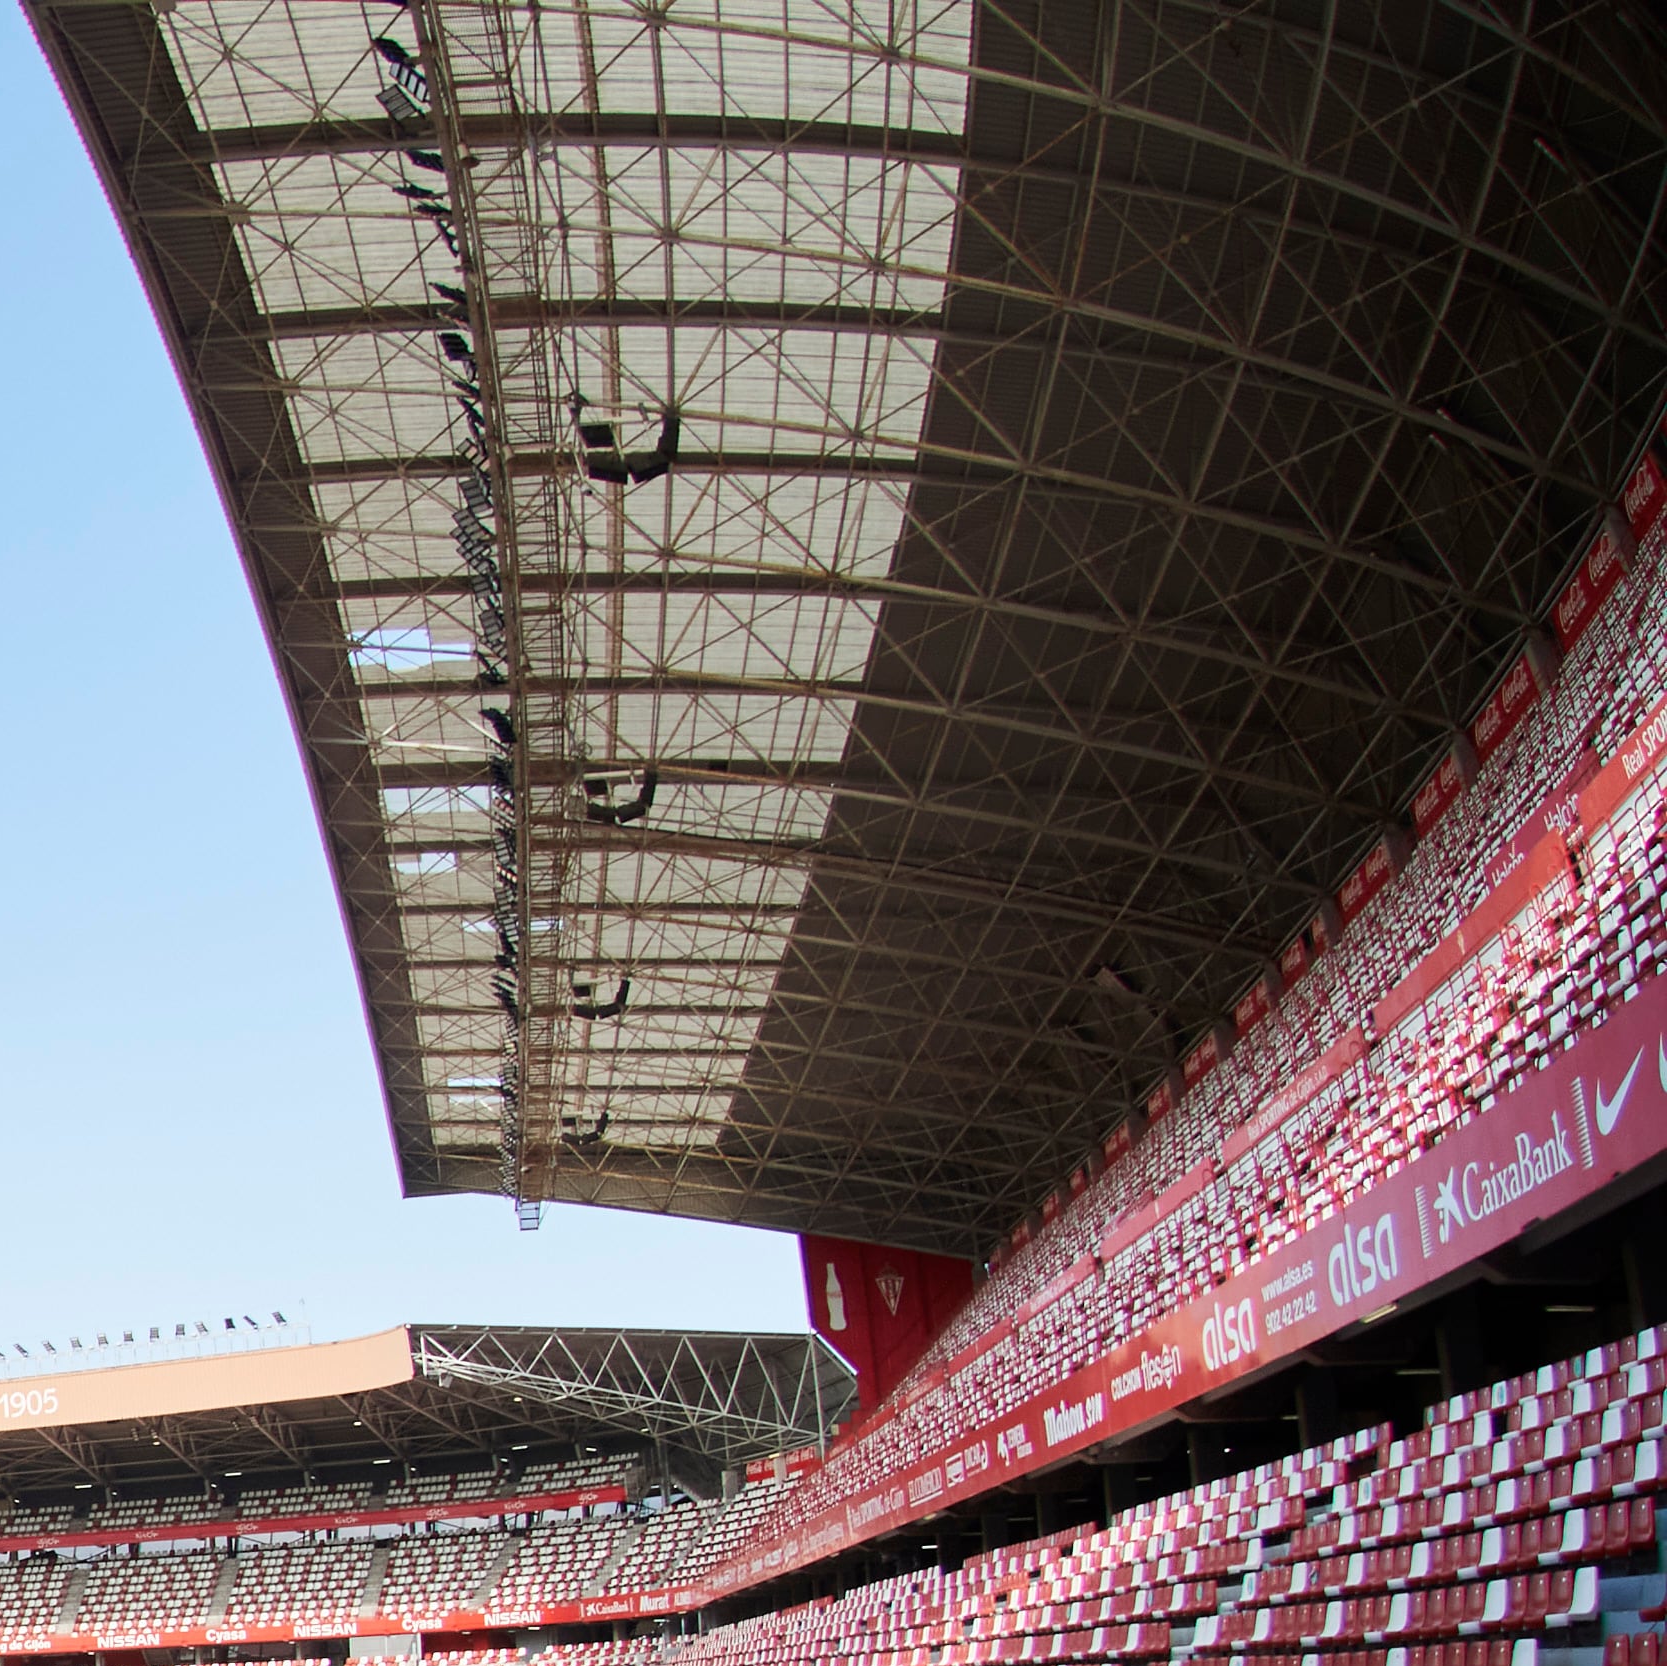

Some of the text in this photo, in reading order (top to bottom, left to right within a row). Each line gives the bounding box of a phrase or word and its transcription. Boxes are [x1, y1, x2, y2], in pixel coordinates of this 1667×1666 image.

[1624, 462, 1655, 523] Coca-Cola
[1558, 578, 1586, 633] Coca-Cola
[1502, 659, 1529, 713] Coca-Cola
[1622, 738, 1645, 780] Real
[1461, 1110, 1573, 1222] CaixaBank
[1328, 1213, 1397, 1307] alsa
[1261, 1260, 1313, 1304] www.alsa.es
[1202, 1297, 1256, 1371] alsa
[1265, 1290, 1317, 1336] 902 42 22 42
[0, 1387, 59, 1418] 1905
[1043, 1400, 1085, 1448] Mahou
[914, 1467, 941, 1500] COMERCIO
[205, 1629, 246, 1643] Cyasa
[293, 1623, 357, 1638] NISSAN
[402, 1618, 442, 1632] Cyasa
[484, 1610, 541, 1626] NISSAN
[9, 1641, 22, 1651] de
[23, 1639, 51, 1651] Gijón
[97, 1634, 159, 1648] NISSAN
